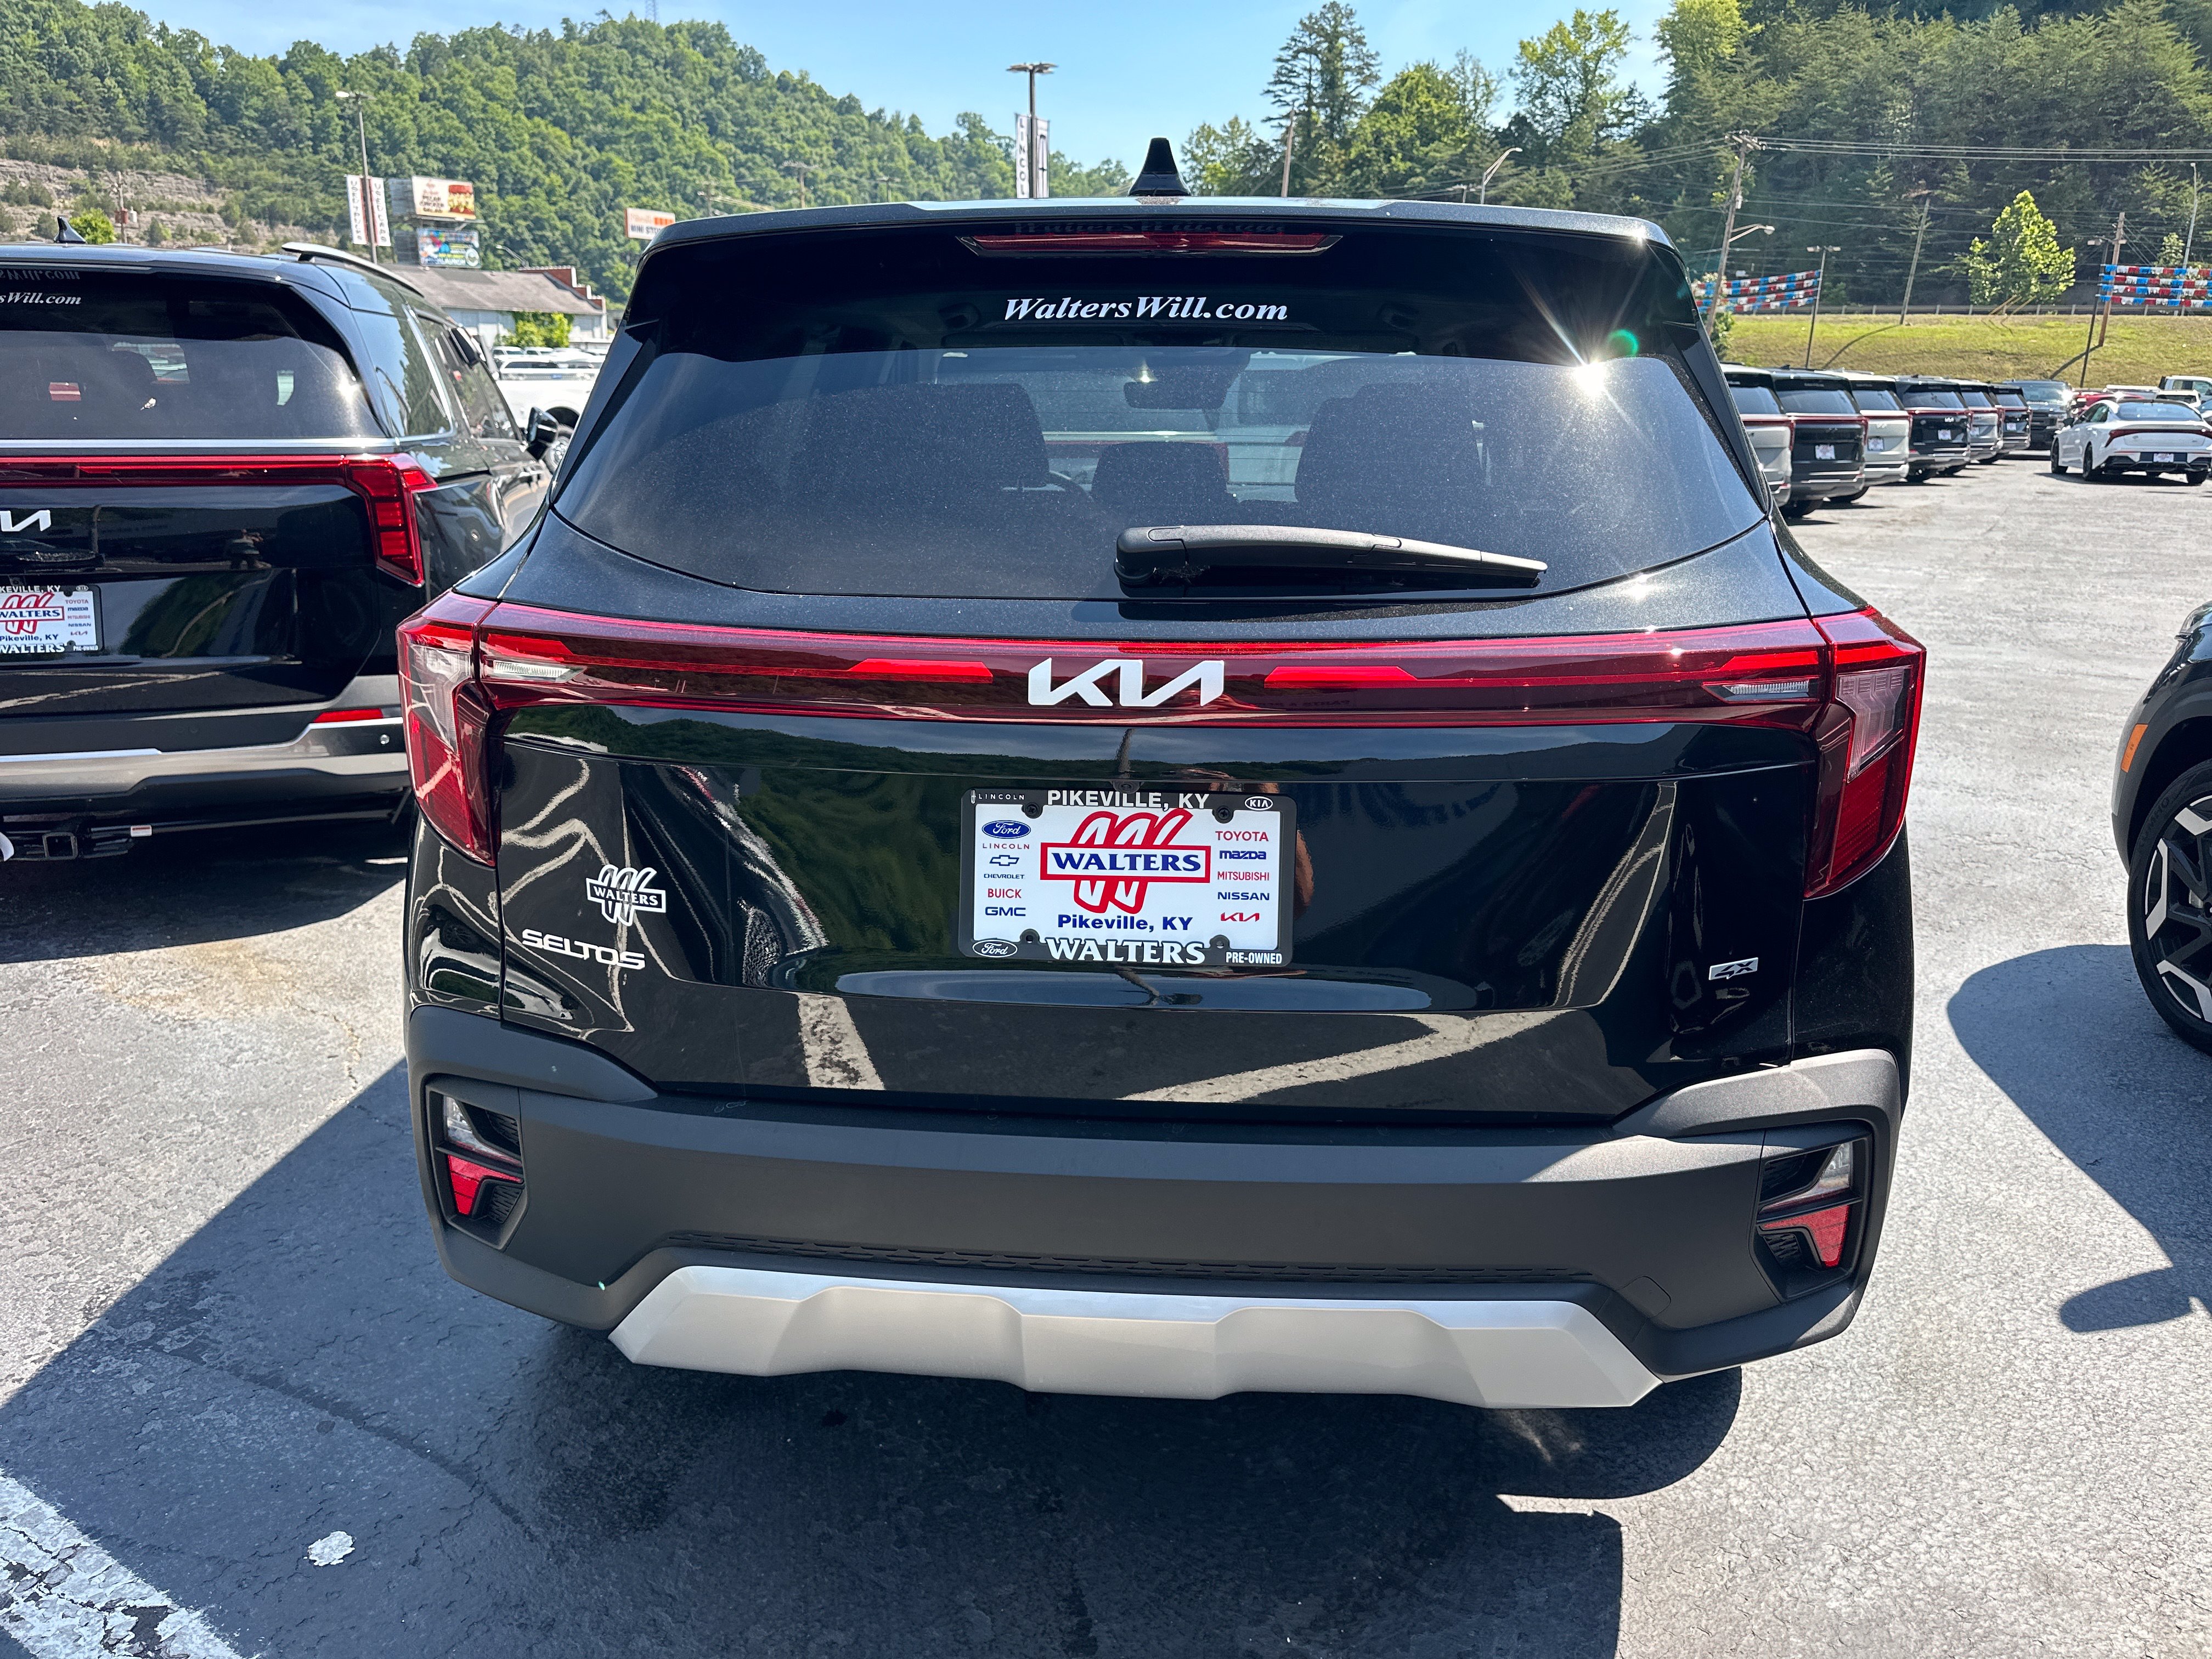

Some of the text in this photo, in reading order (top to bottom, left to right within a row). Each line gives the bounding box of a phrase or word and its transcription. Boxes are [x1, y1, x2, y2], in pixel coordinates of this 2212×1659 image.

[1005, 296, 1288, 320] WaltersWill.com
[1028, 657, 1224, 707] KIA
[1047, 790, 1210, 812] PIKEVILLE, KY
[1250, 799, 1269, 808] KIA
[992, 822, 1022, 834] Ford
[1215, 831, 1269, 842] TOYOTA
[1052, 852, 1201, 871] WALTERS
[1217, 871, 1269, 881] MITSUBISHI
[593, 885, 658, 906] WALTERS
[988, 888, 1022, 899] BUICK
[1217, 891, 1270, 901] NISSAN
[985, 906, 1026, 917] GMC
[1221, 912, 1260, 922] KIA
[1058, 914, 1193, 932] Pikeville, KY
[522, 928, 646, 970] SELTOS
[981, 942, 1008, 956] Ford
[1045, 937, 1206, 964] WALTERS
[1225, 951, 1283, 964] PRE-OWNED
